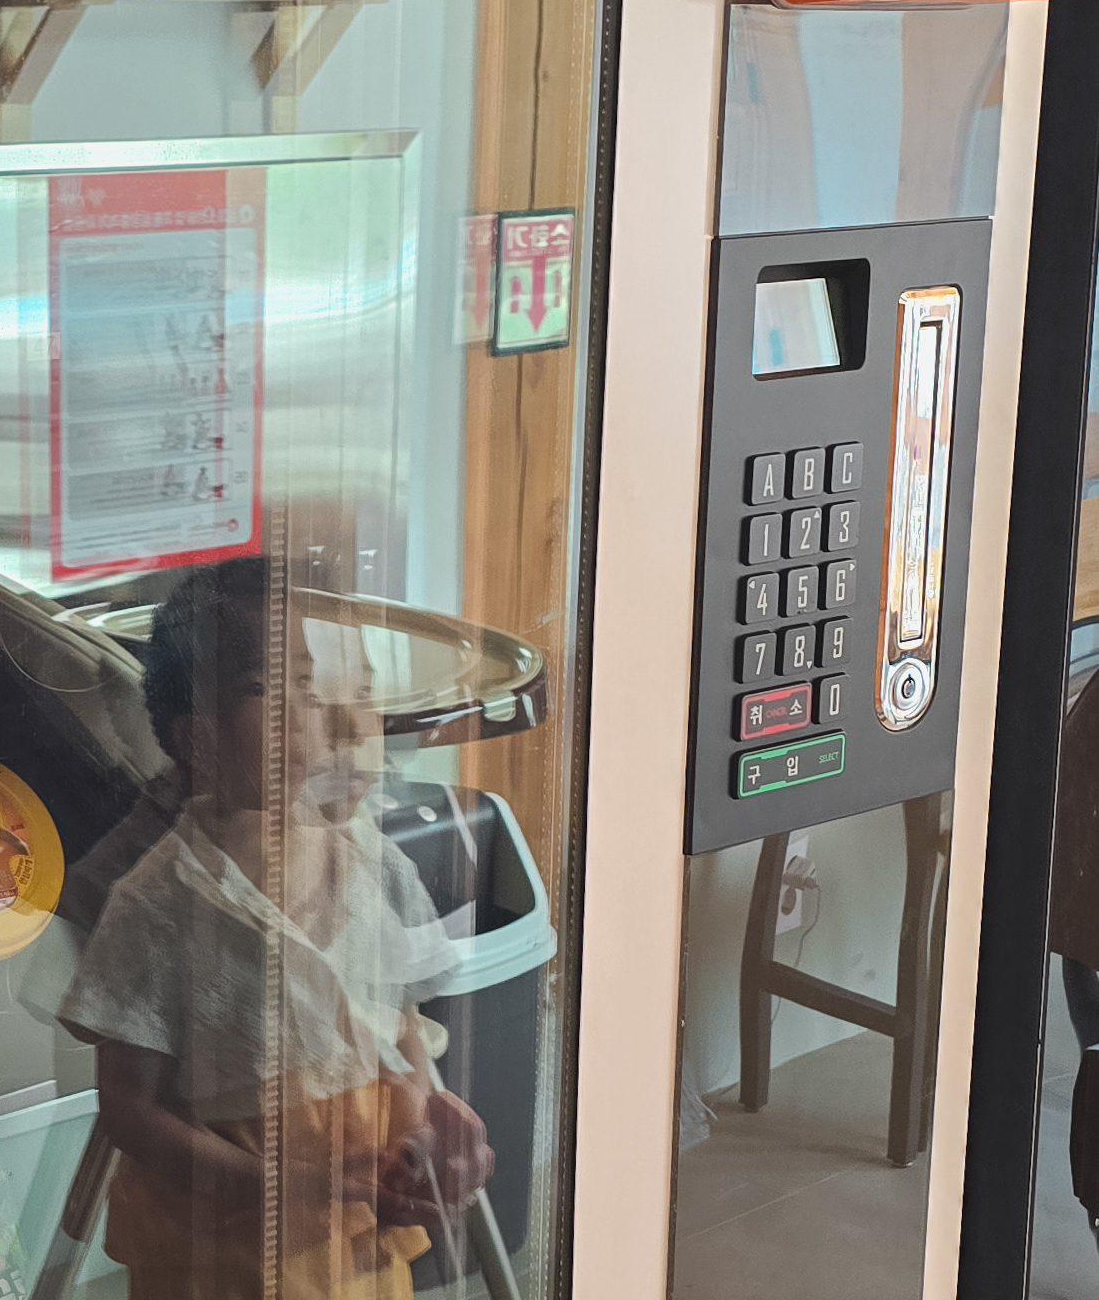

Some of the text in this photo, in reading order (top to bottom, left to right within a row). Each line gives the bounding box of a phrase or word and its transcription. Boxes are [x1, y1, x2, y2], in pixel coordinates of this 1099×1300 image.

[763, 463, 774, 497] A
[803, 458, 814, 491] B
[842, 452, 853, 484] C
[763, 523, 769, 556] 1
[801, 517, 811, 550] 2
[840, 510, 849, 542] 3
[757, 583, 768, 616] 4
[797, 576, 808, 608] 5
[836, 569, 846, 601] 6
[755, 642, 766, 675] 7
[794, 635, 804, 668] 8
[833, 626, 843, 658] 9
[750, 699, 803, 725] 취 소
[829, 683, 839, 716] 0
[748, 751, 839, 785] 구 입 SELECT
